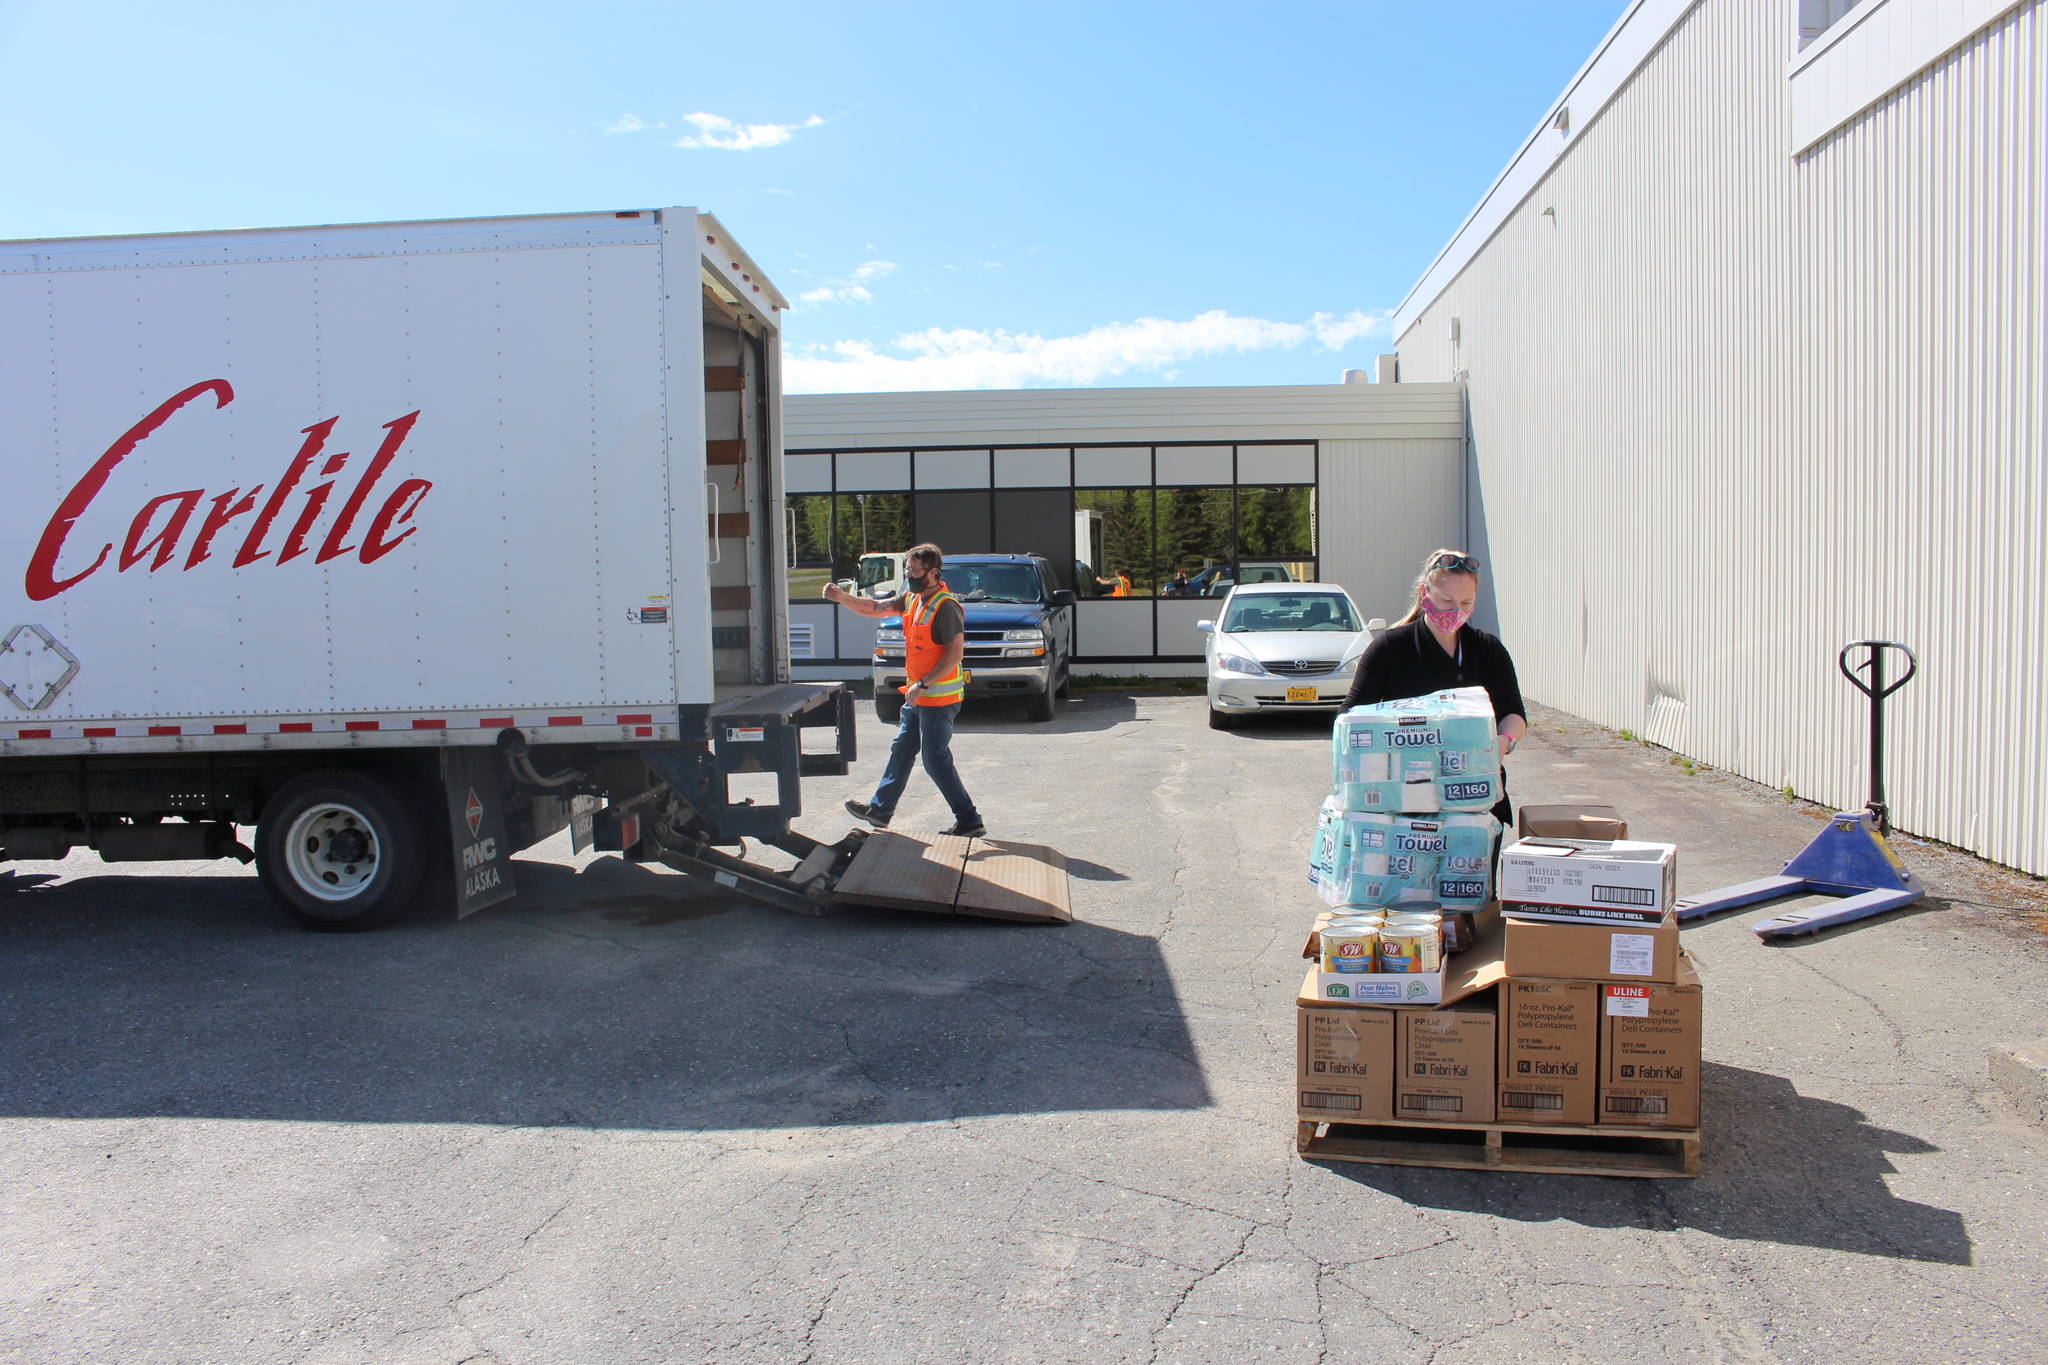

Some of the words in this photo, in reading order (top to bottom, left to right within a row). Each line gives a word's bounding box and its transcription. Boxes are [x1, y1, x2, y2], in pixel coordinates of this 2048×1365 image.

[25, 378, 432, 601] Carlile
[1384, 729, 1443, 747] Towel
[1448, 785, 1460, 795] 12
[1464, 784, 1488, 794] 160
[1395, 834, 1447, 852] Towel
[462, 837, 497, 872] RWC
[465, 867, 500, 898] ALASKA
[1442, 882, 1456, 892] 12
[1460, 883, 1482, 892] 160
[1518, 904, 1538, 912] Tastes
[1539, 905, 1553, 914] Like
[1578, 910, 1606, 918] BURNS
[1614, 987, 1643, 996] ULINE
[1518, 1012, 1574, 1021] Polypropylene
[1622, 1016, 1680, 1025] Polypropylene
[1535, 1022, 1577, 1030] Containers
[1640, 1026, 1682, 1034] Containers
[1414, 1036, 1462, 1044] Polypropylene
